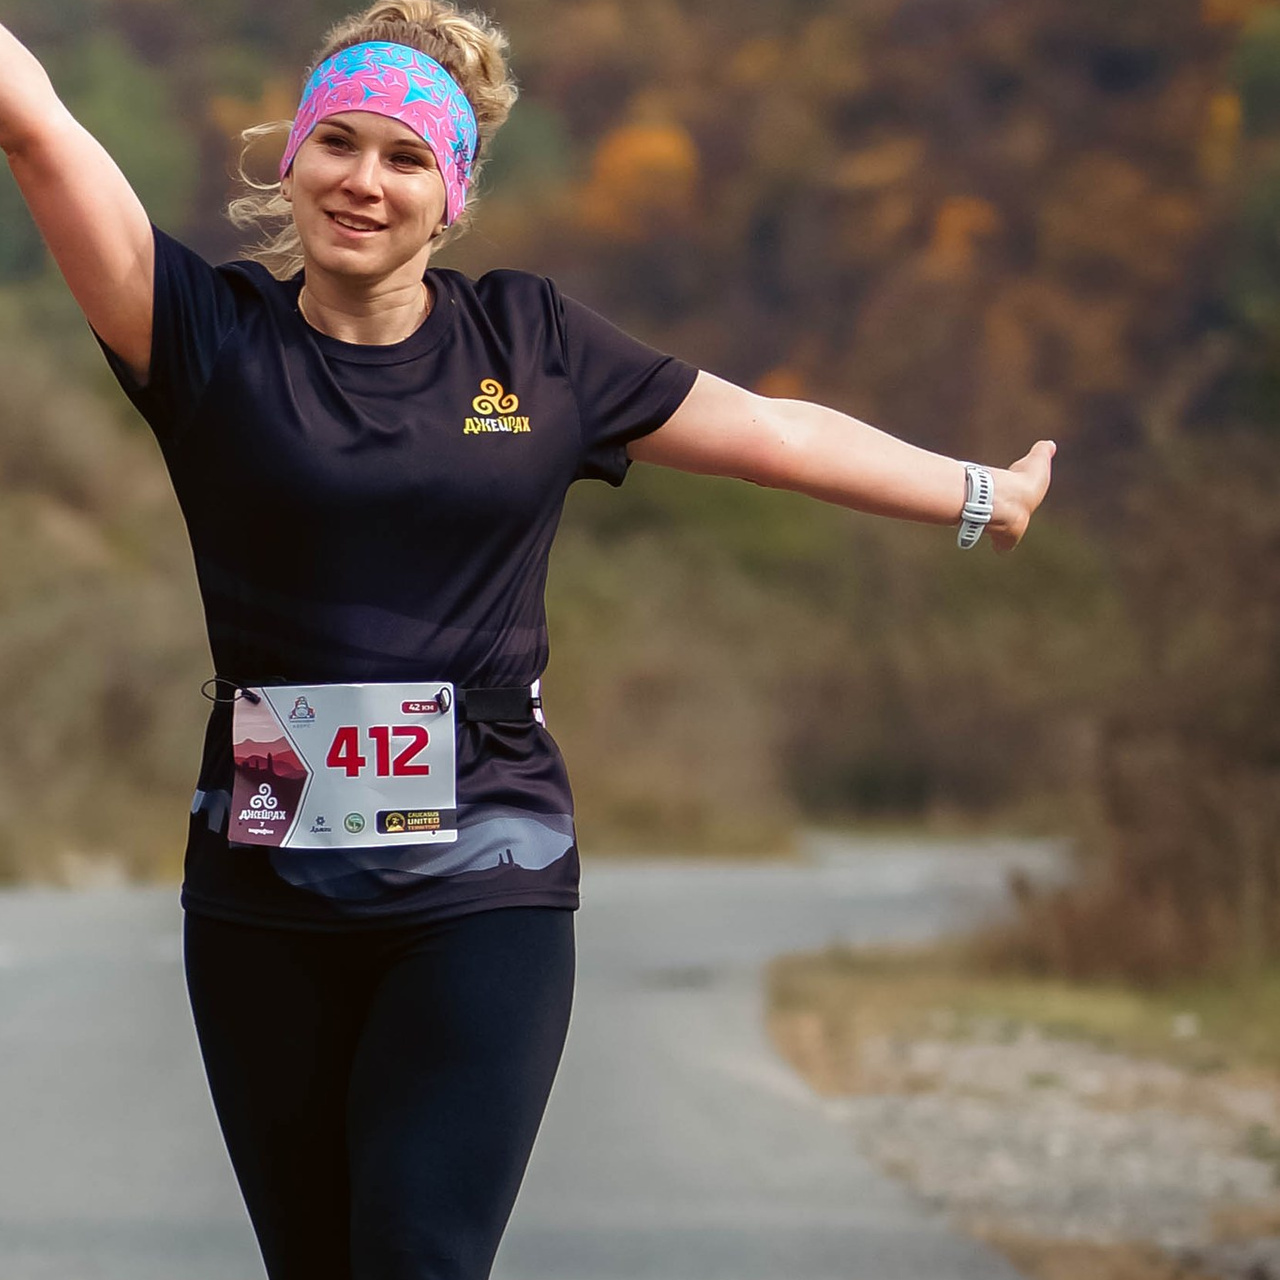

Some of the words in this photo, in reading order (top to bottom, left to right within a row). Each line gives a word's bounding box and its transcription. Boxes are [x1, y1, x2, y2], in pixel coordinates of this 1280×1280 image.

[463, 416, 531, 434] ДЖЕЙРАХ
[409, 703, 421, 711] 42
[326, 725, 430, 777] 412
[238, 809, 286, 821] ДЖЕЙРАХ
[407, 817, 440, 825] UNITED
